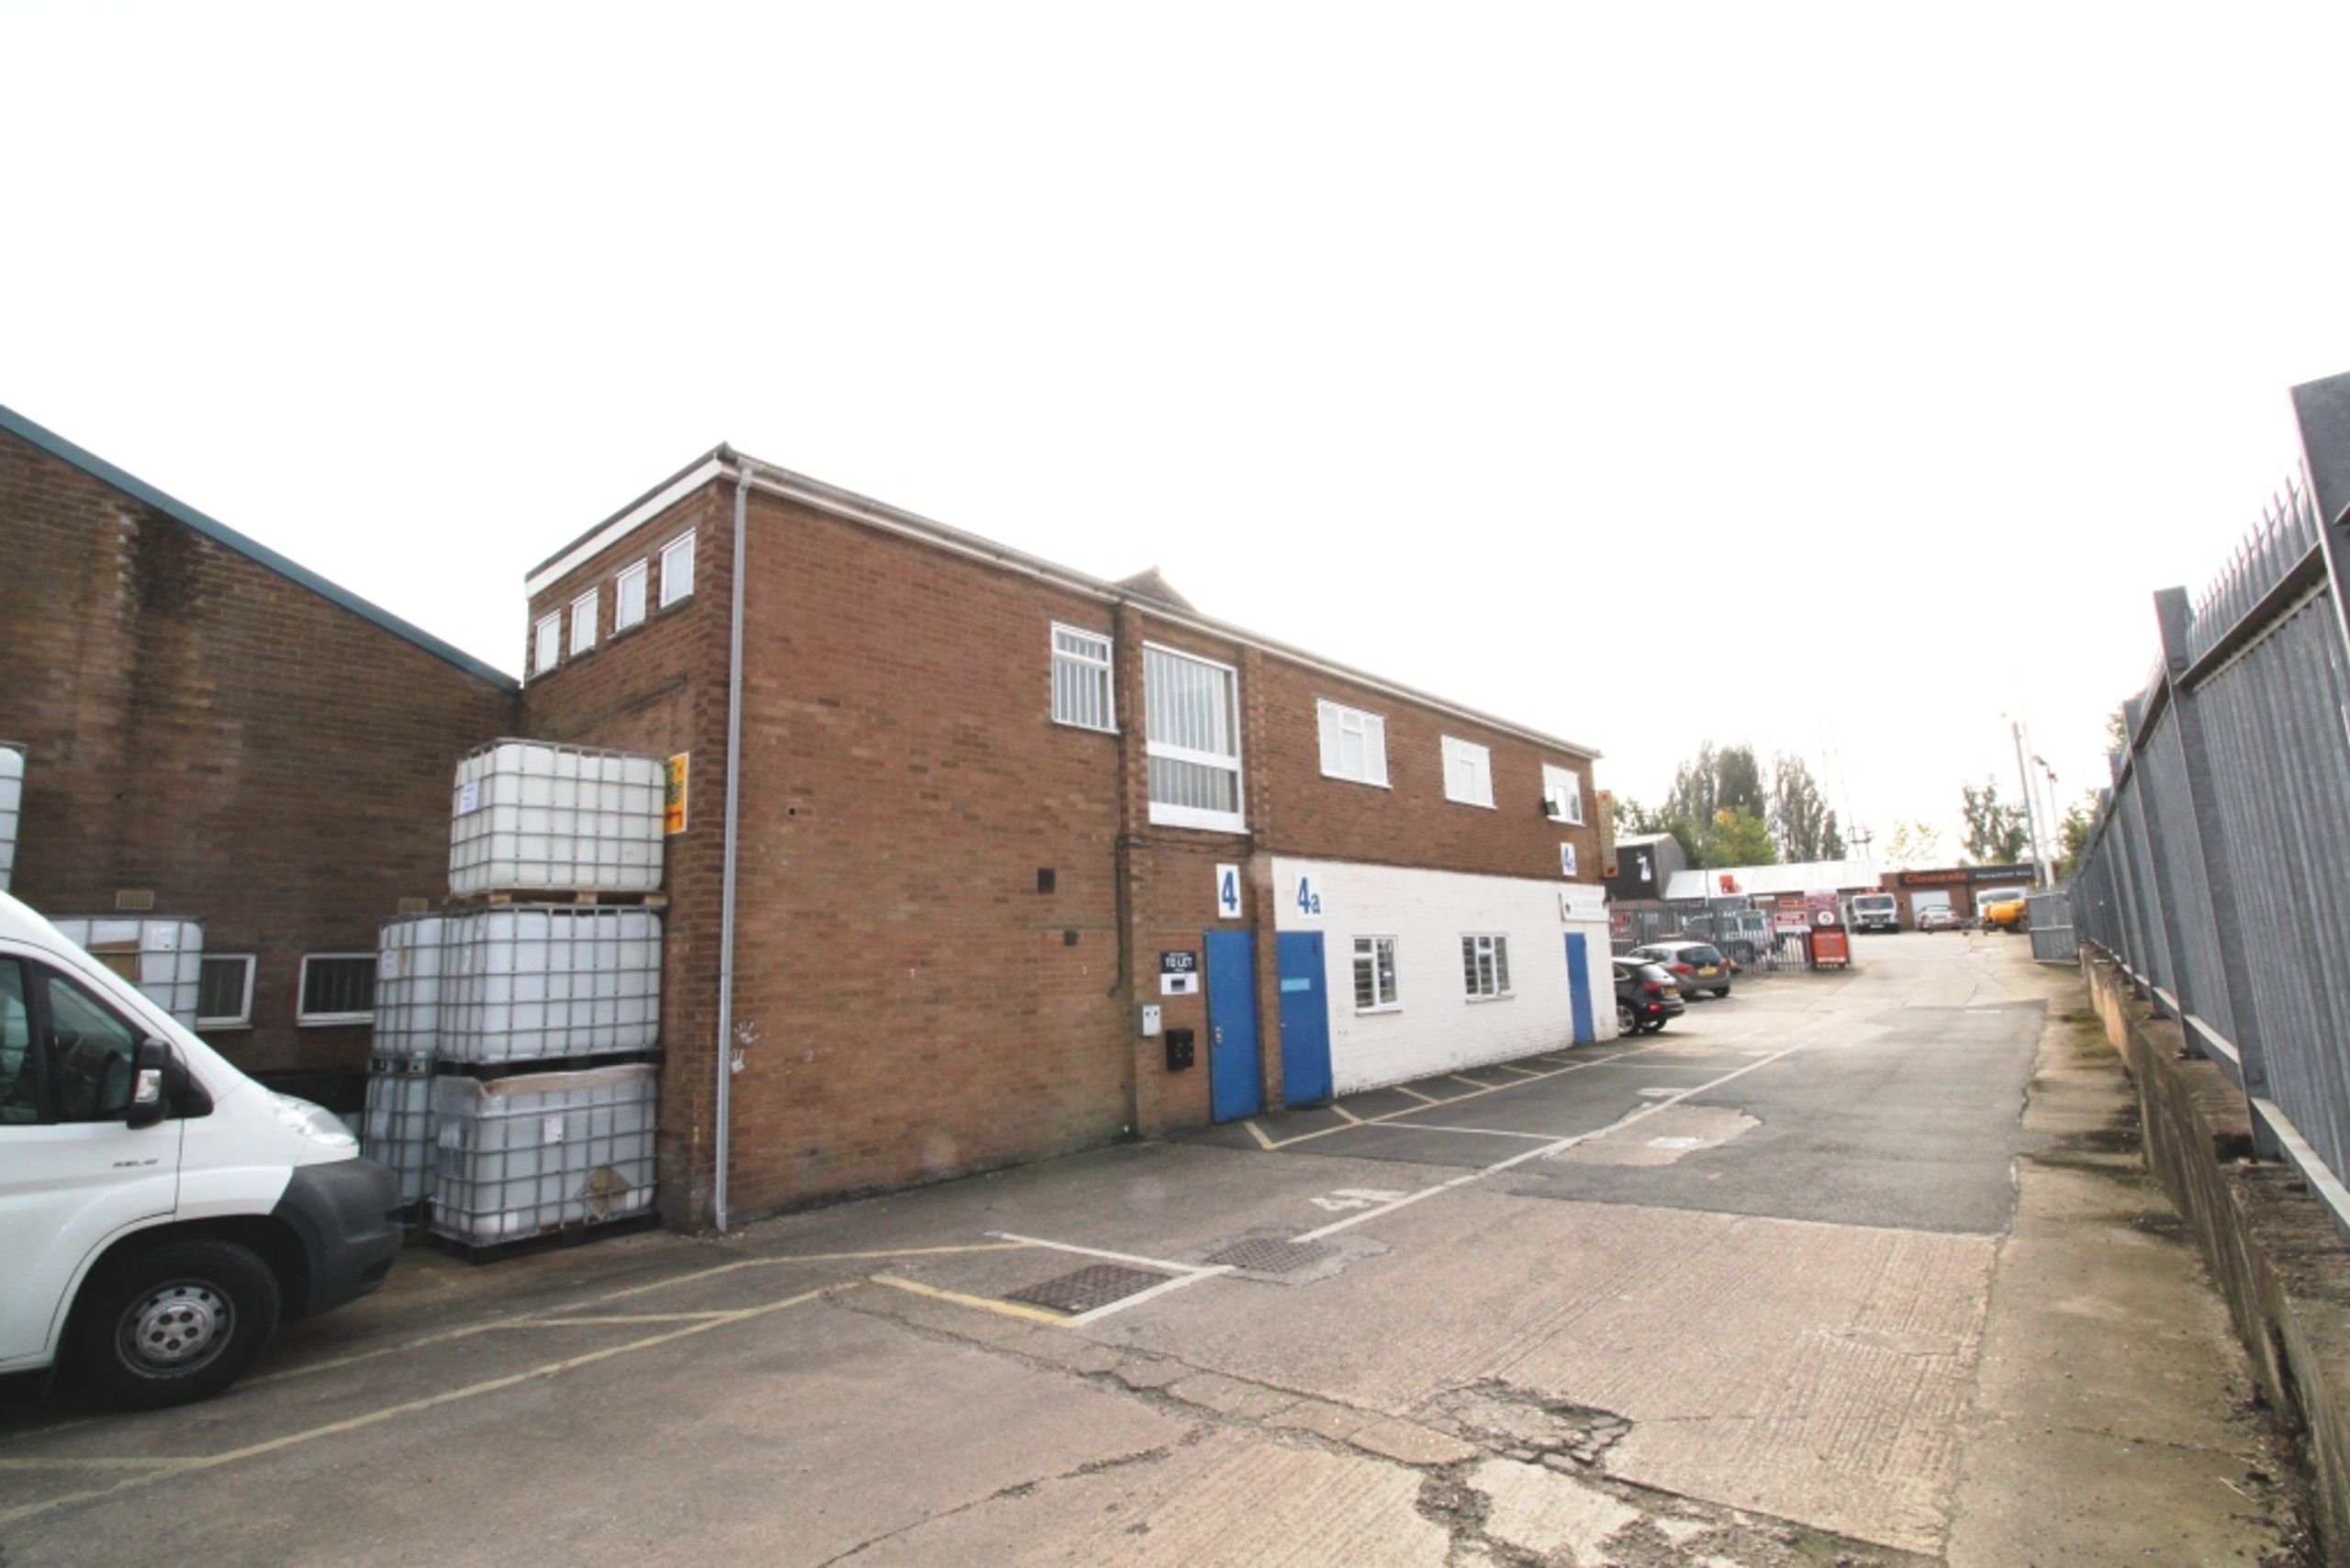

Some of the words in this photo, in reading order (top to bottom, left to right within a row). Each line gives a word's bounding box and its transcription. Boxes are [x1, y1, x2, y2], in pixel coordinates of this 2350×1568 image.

[1221, 870, 1237, 912] 4
[1297, 876, 1321, 914] 4a
[1177, 956, 1192, 969] LET
